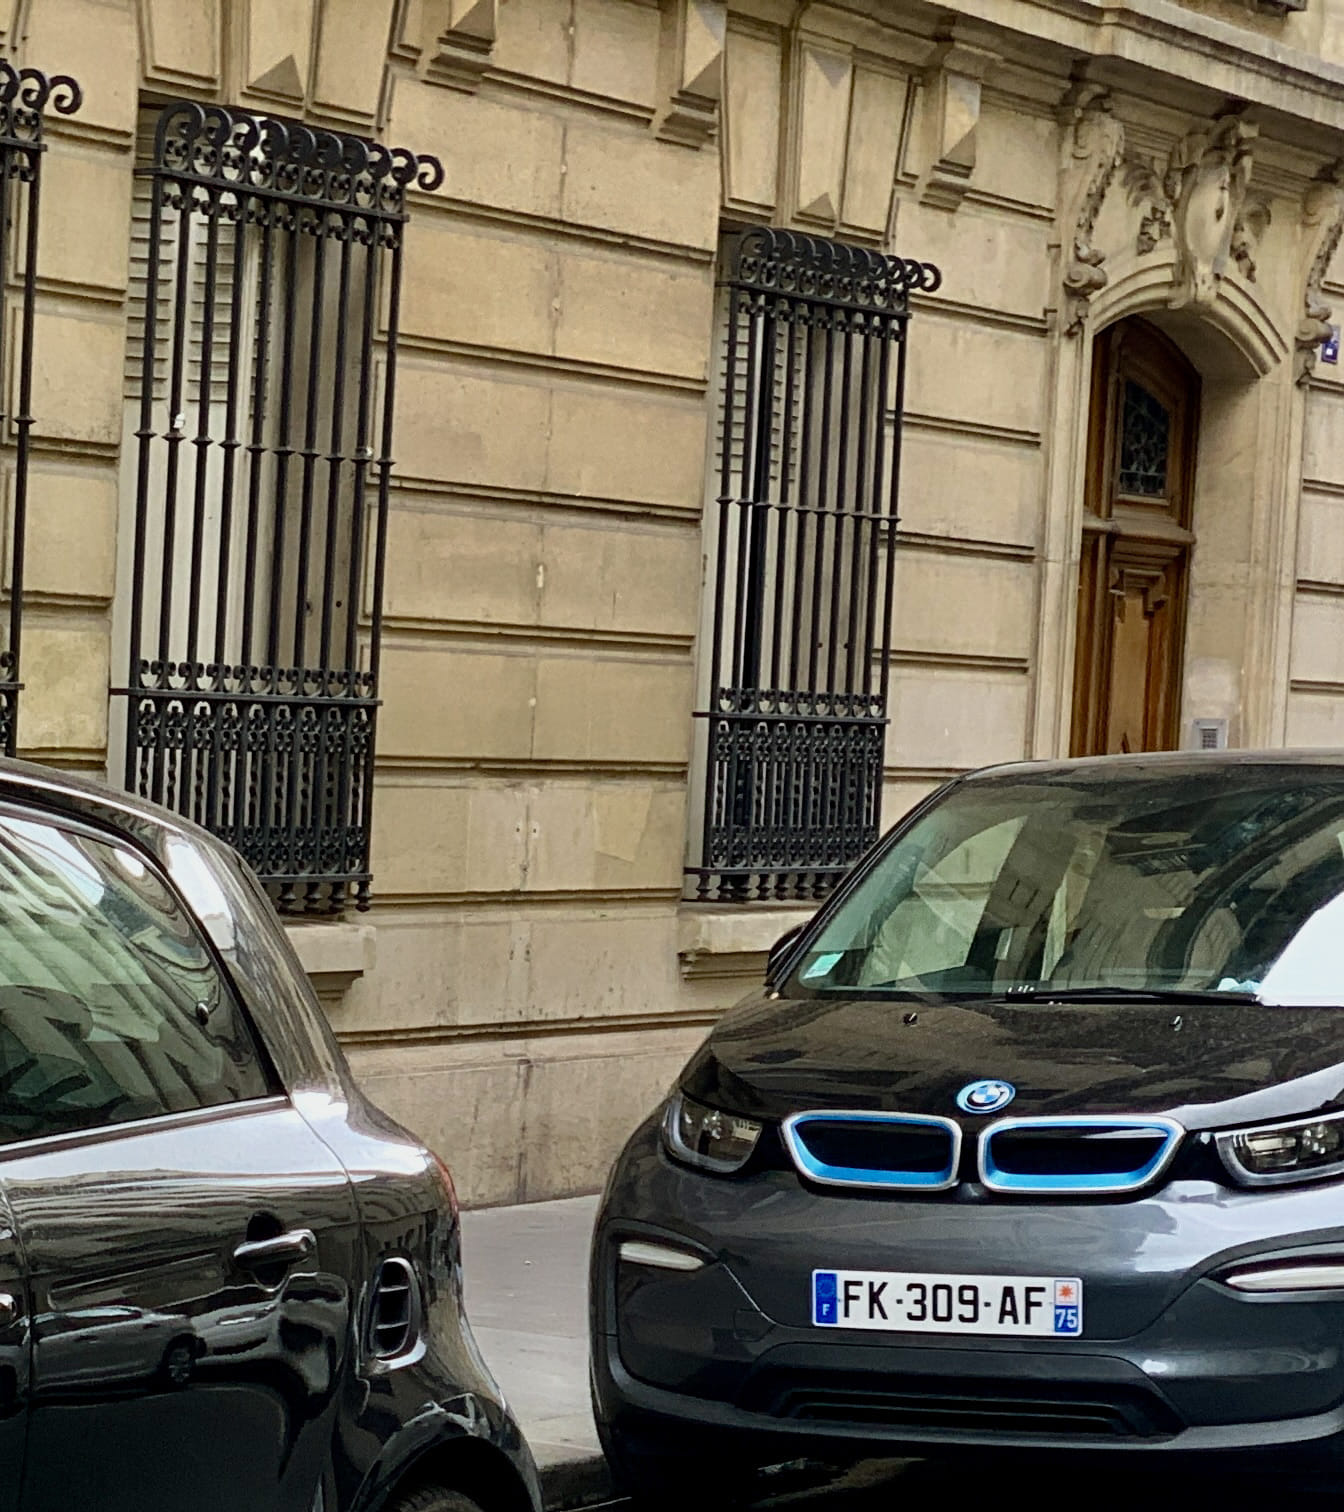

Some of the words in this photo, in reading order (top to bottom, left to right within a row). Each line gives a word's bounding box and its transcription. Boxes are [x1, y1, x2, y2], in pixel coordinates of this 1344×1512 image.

[822, 1303, 831, 1316] F
[843, 1280, 1046, 1325] FK-309-AF
[1055, 1308, 1078, 1330] 75
